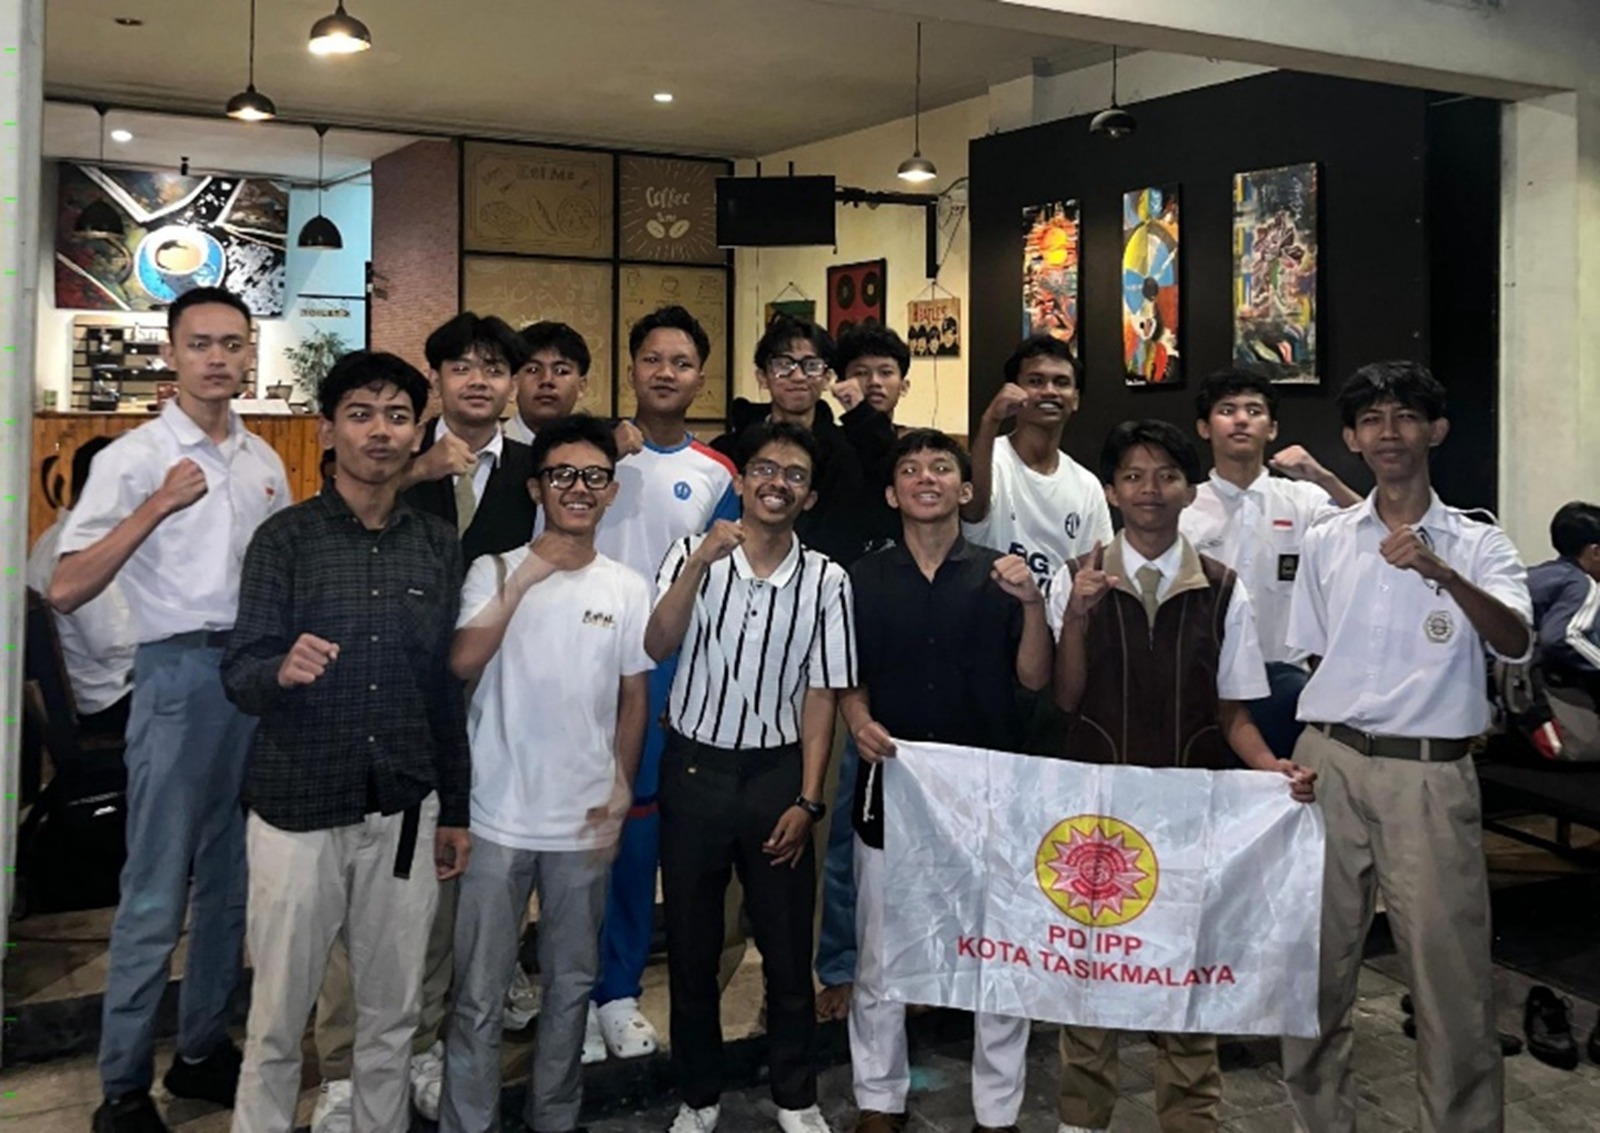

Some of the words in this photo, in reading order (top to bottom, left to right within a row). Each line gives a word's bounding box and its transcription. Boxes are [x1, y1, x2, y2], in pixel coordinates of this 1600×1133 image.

[645, 186, 691, 208] Coffee
[1049, 925, 1088, 949] PD
[1096, 932, 1143, 957] IPP
[957, 935, 1032, 967] KOTA
[1038, 950, 1237, 987] TASIKMALAYA
